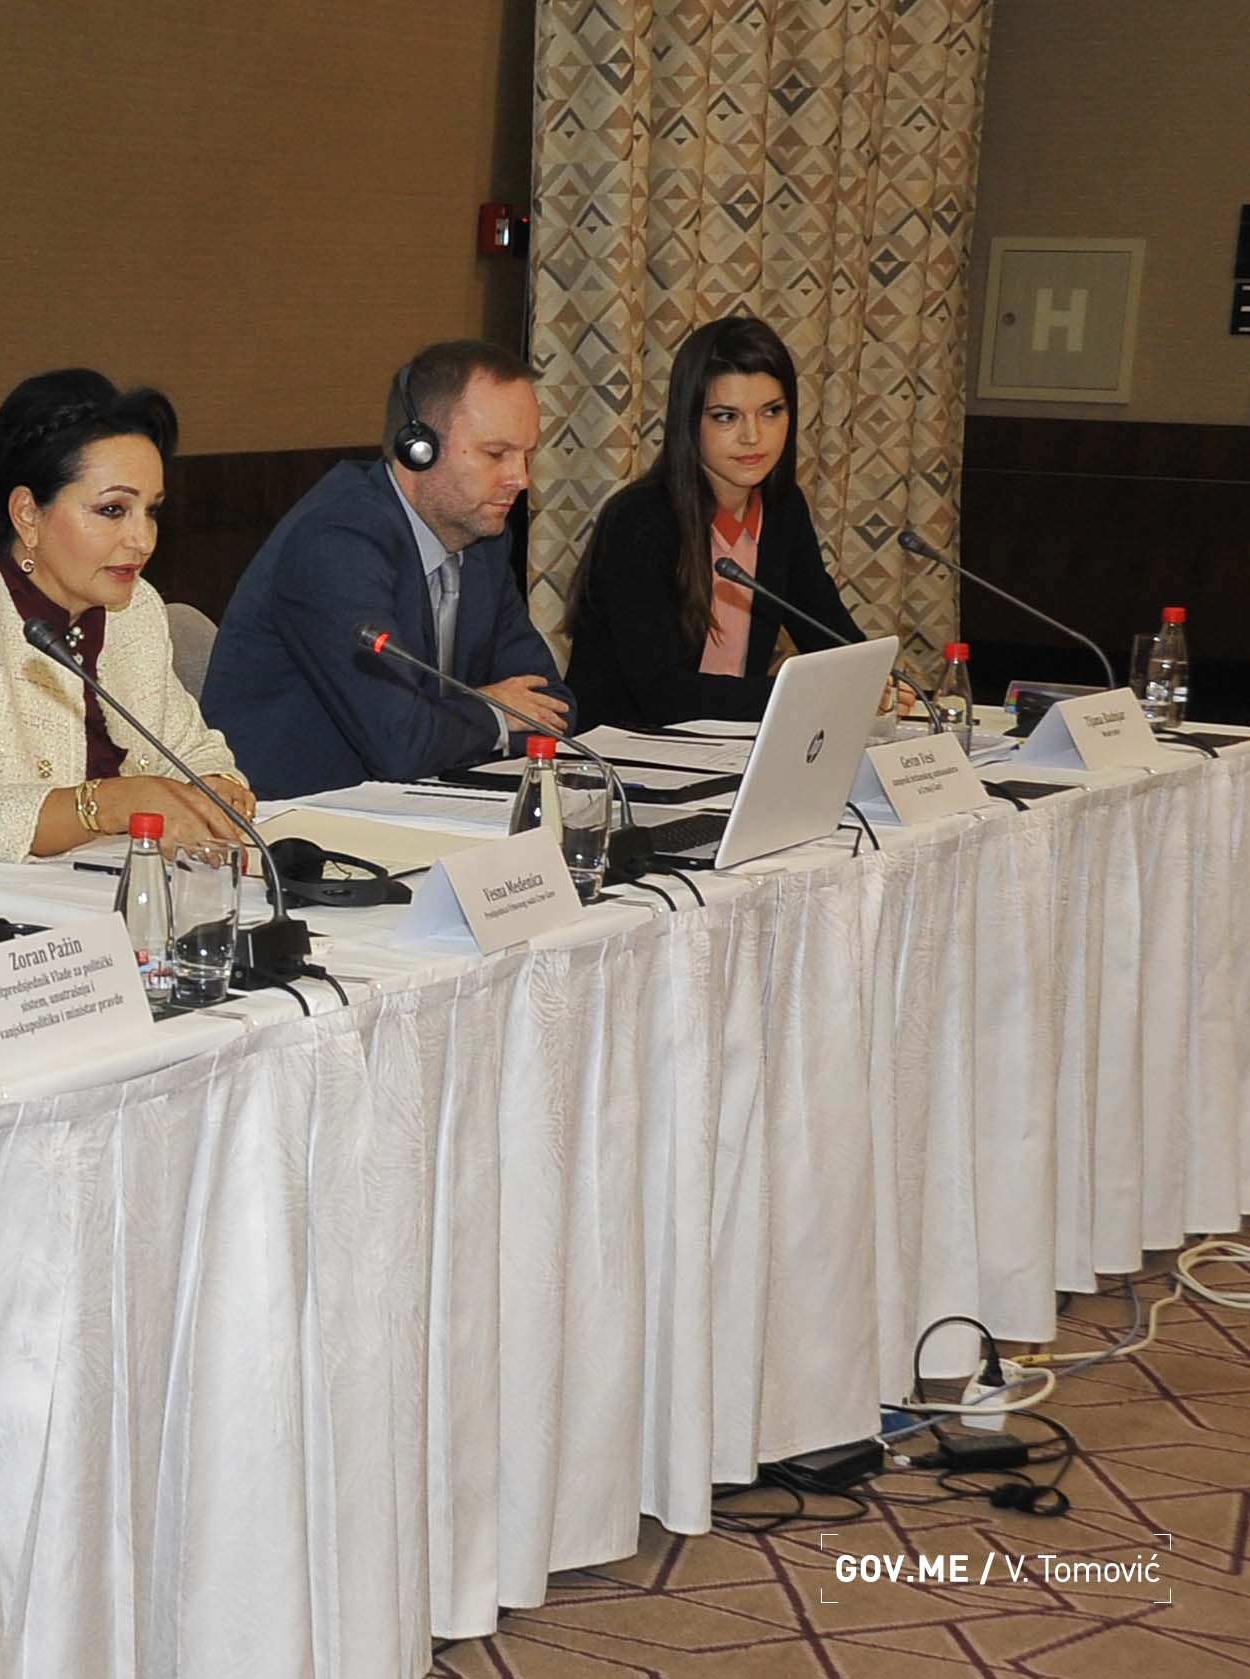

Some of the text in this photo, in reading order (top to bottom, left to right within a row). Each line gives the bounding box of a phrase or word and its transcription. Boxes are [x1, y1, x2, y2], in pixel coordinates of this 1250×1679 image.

[1032, 288, 1089, 352] H
[482, 872, 544, 902] Vesna Medenica
[8, 937, 83, 972] Zoran Pažin
[49, 967, 72, 983] Vlade
[72, 966, 83, 977] za
